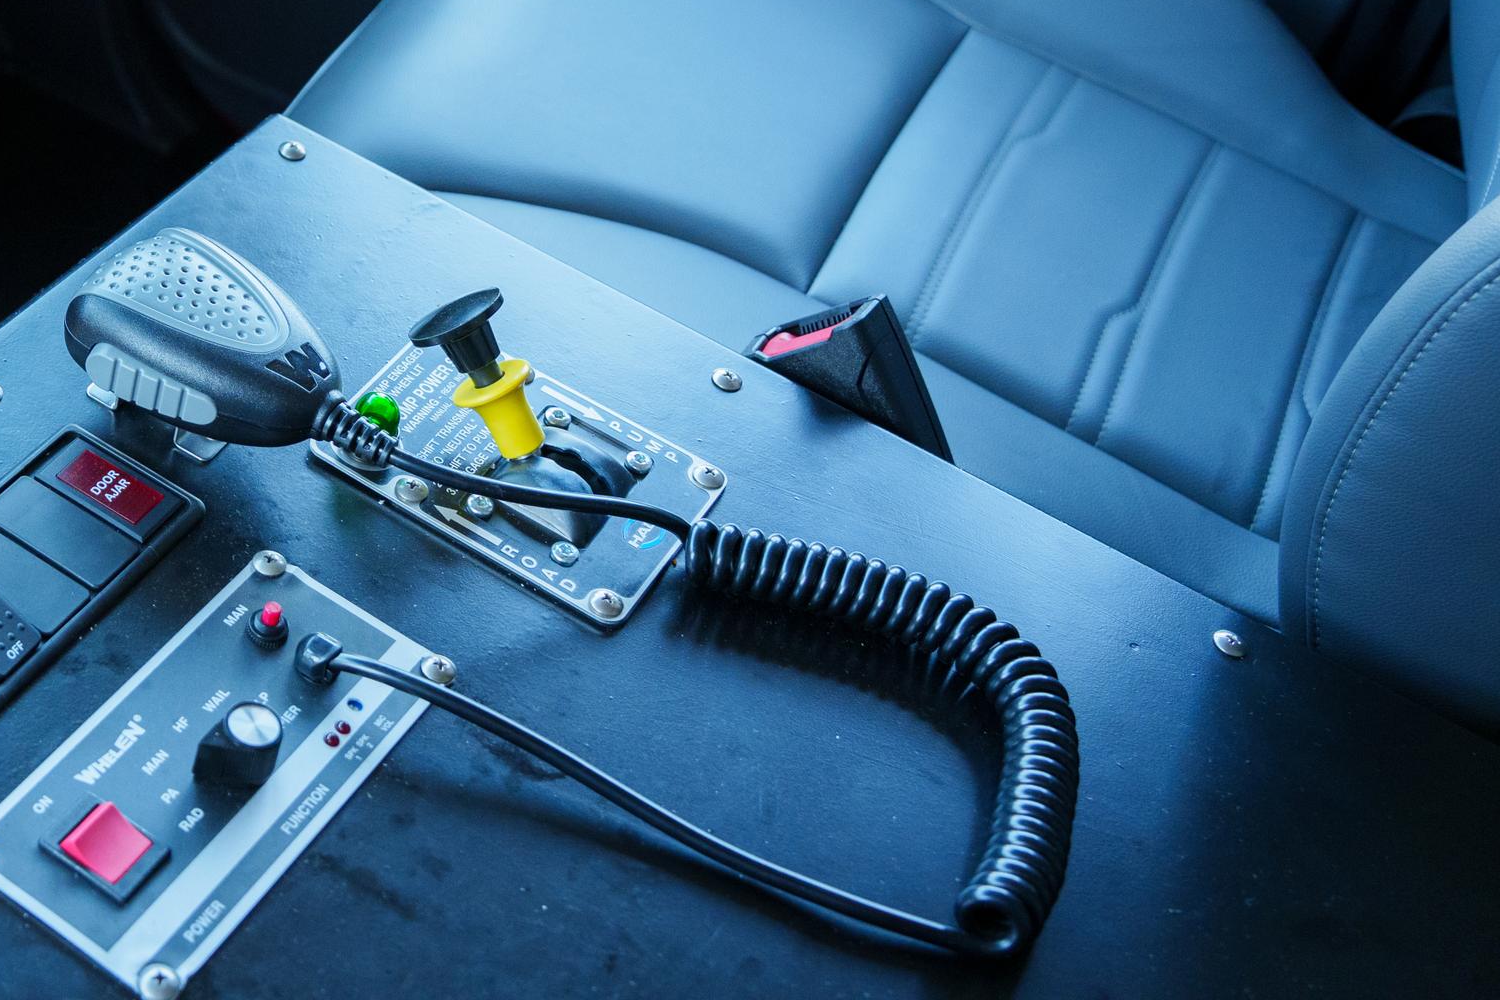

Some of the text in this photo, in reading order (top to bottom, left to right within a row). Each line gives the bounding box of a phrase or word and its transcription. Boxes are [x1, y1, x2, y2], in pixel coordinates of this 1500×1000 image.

[387, 348, 424, 382] ENGAGED
[391, 363, 425, 397] WHEN LIT
[400, 364, 453, 420] UMP POWER
[402, 399, 439, 433] WARNING
[419, 438, 440, 460] SHIFT
[436, 407, 473, 439] TRANSMI
[609, 420, 679, 464] PUMP
[449, 425, 491, 472] HIFT TO PUM
[465, 451, 489, 475] GAGE
[90, 470, 120, 495] DOOR
[104, 478, 131, 502] AJAR
[500, 544, 577, 593] ROAD
[223, 603, 249, 627] MAN
[6, 640, 26, 660] OFF
[202, 689, 231, 713] WAIL
[172, 716, 189, 733] HF
[280, 705, 302, 727] IER
[141, 749, 170, 776] MAN
[32, 795, 53, 814] ON
[160, 788, 180, 804] PA
[178, 807, 205, 832] RAD
[280, 783, 330, 836] FUNCTION
[183, 899, 226, 943] POWER
